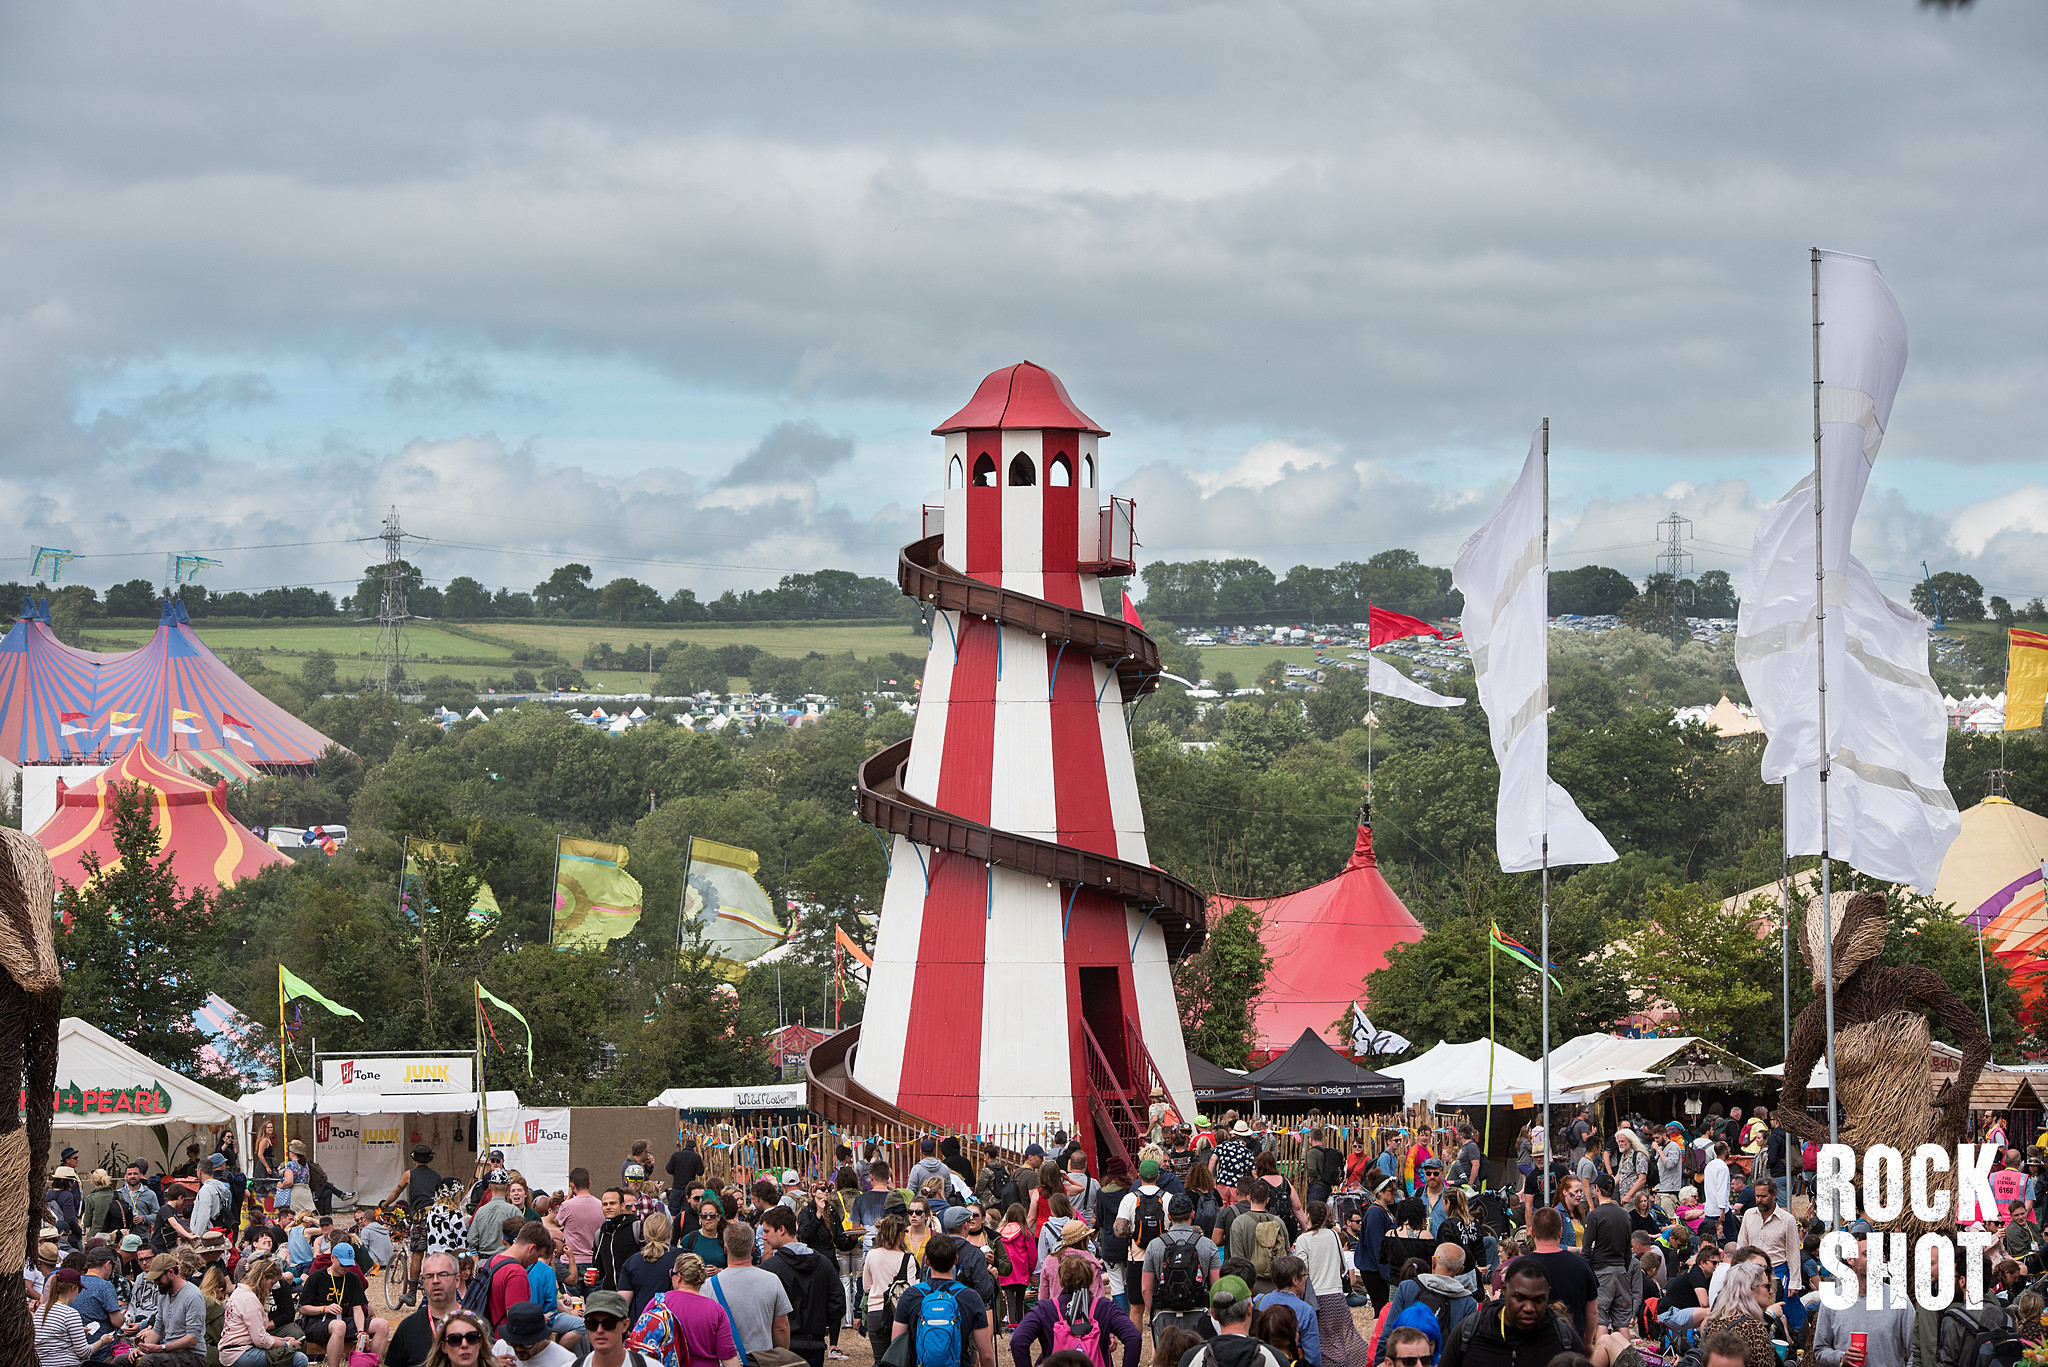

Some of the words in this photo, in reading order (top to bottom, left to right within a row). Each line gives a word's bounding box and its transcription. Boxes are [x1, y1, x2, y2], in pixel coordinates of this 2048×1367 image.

[342, 1063, 353, 1083] Hi
[354, 1069, 381, 1081] Tone
[403, 1065, 450, 1083] JUNK
[403, 1082, 451, 1090] GUITARS
[1307, 1086, 1320, 1095] Cu
[1321, 1085, 1351, 1096] Designs
[82, 1090, 167, 1113] PEARL
[737, 1092, 790, 1106] Wildflower
[317, 1119, 329, 1140] Hi
[330, 1126, 359, 1139] Tone
[360, 1128, 401, 1145] JUNK
[526, 1121, 538, 1142] Hi
[539, 1128, 568, 1141] Tone
